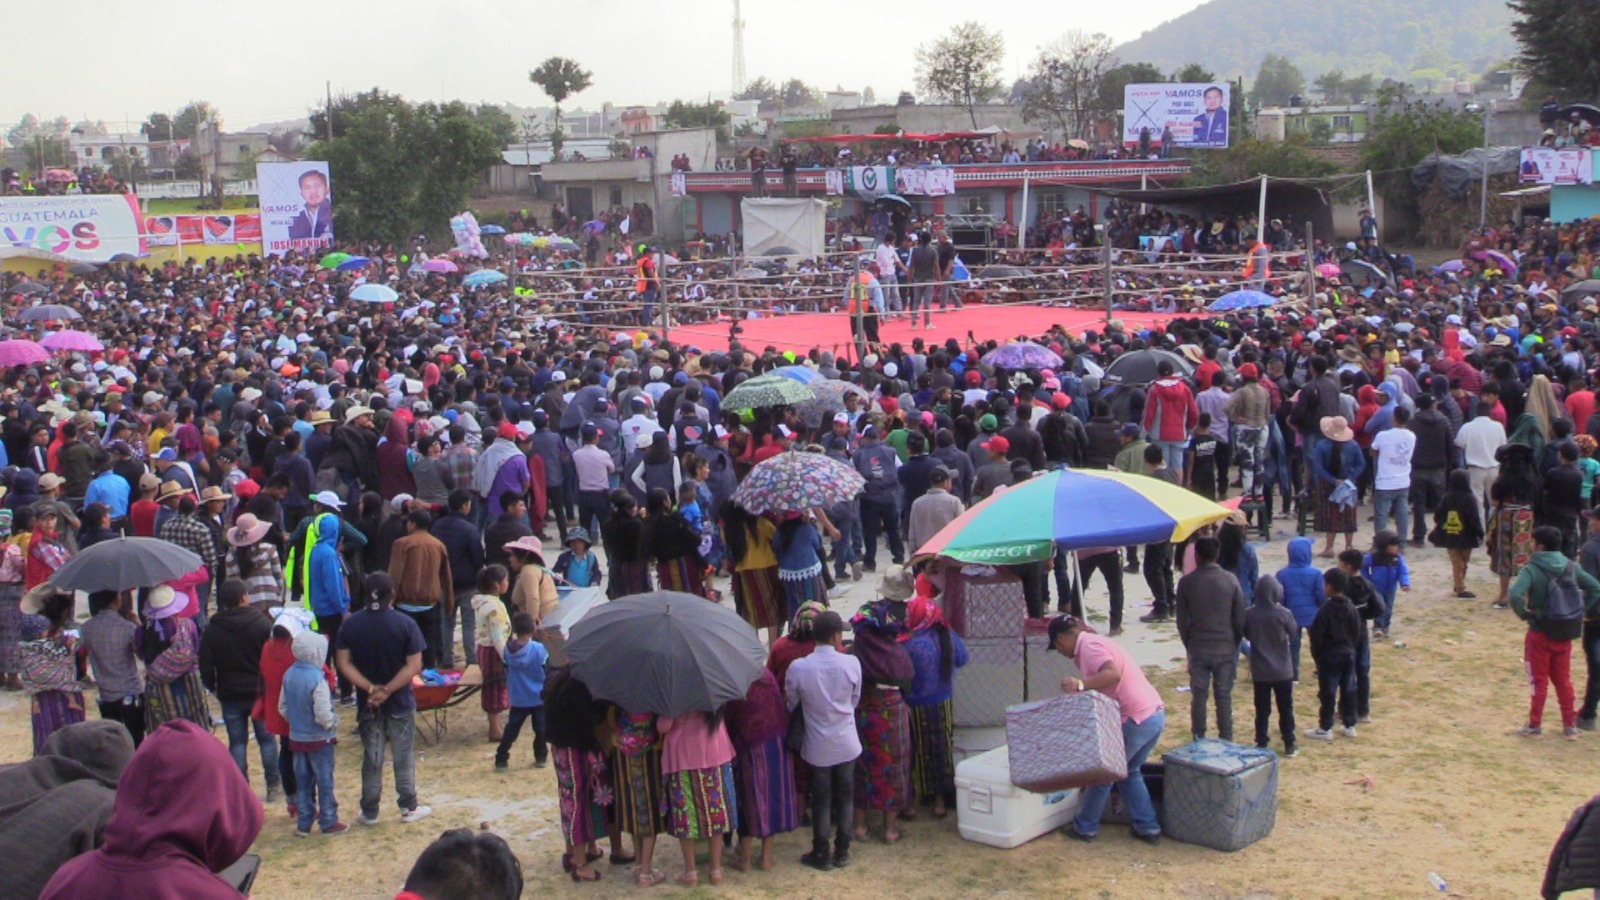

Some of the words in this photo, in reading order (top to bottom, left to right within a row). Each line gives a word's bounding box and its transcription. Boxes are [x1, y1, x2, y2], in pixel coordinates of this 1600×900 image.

[1165, 90, 1202, 98] VAMOS
[1128, 127, 1162, 136] VAOS
[262, 204, 299, 213] VAMOS
[0, 208, 99, 223] GUATEMALA
[4, 221, 100, 253] VOS
[960, 544, 1037, 559] DIRECT
